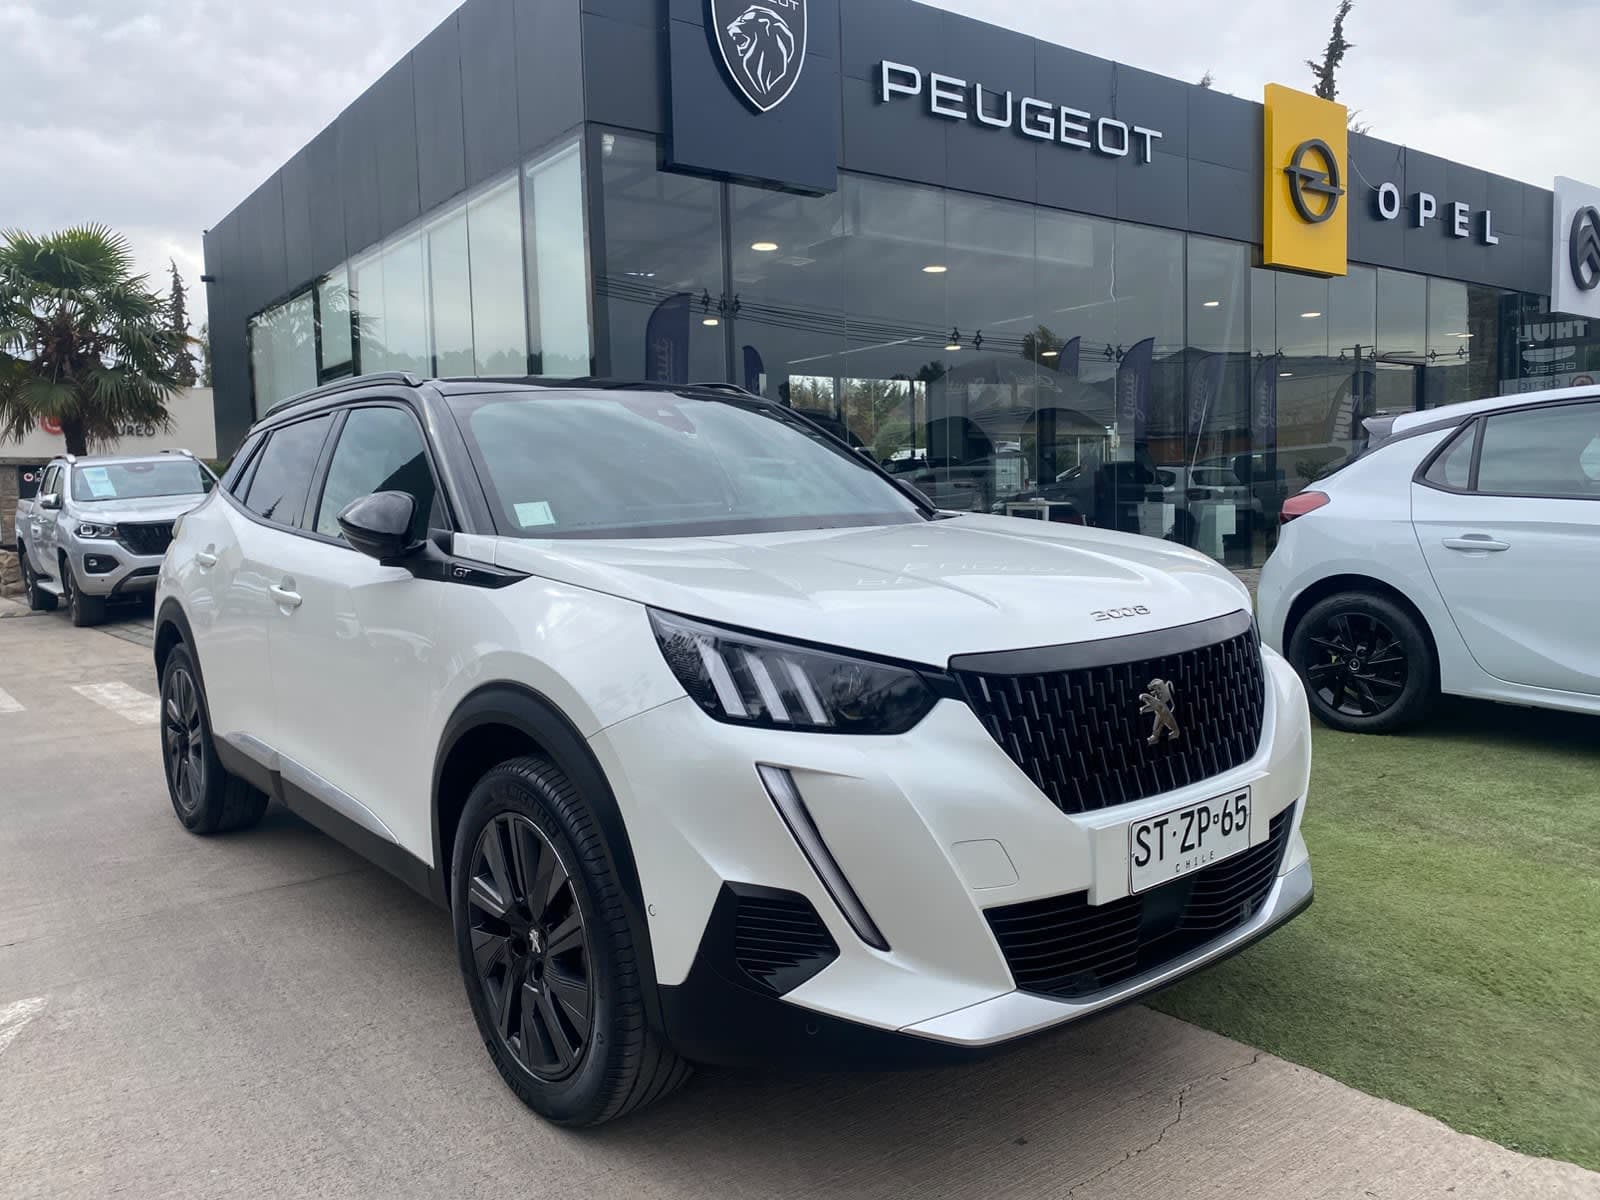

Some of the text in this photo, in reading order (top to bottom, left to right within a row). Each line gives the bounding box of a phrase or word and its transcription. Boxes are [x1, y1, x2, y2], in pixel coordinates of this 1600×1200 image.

[881, 60, 1162, 163] PEUGEOT
[1377, 182, 1498, 244] OPEL
[454, 567, 472, 578] GT
[1090, 605, 1151, 621] 2008
[1175, 850, 1215, 873] CHILE
